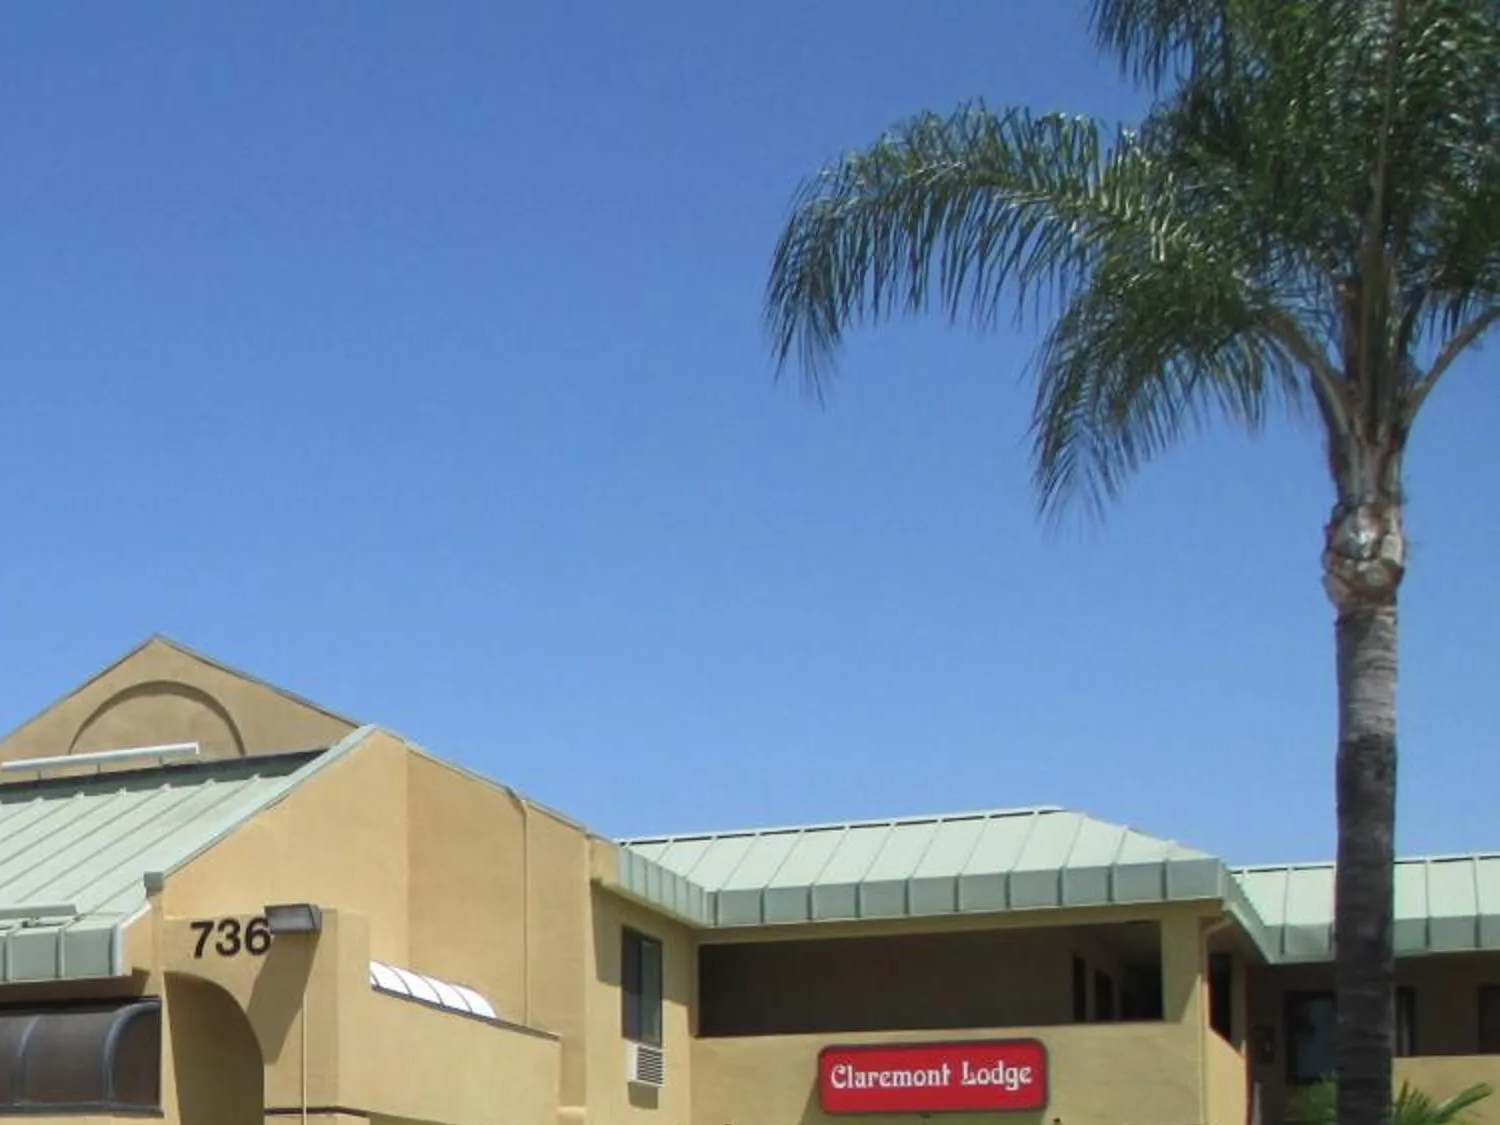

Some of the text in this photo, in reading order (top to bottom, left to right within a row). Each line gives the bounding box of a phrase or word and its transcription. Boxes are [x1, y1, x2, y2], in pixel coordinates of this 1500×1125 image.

[190, 917, 272, 959] 736
[831, 1060, 1033, 1091] Claremont Lodge
